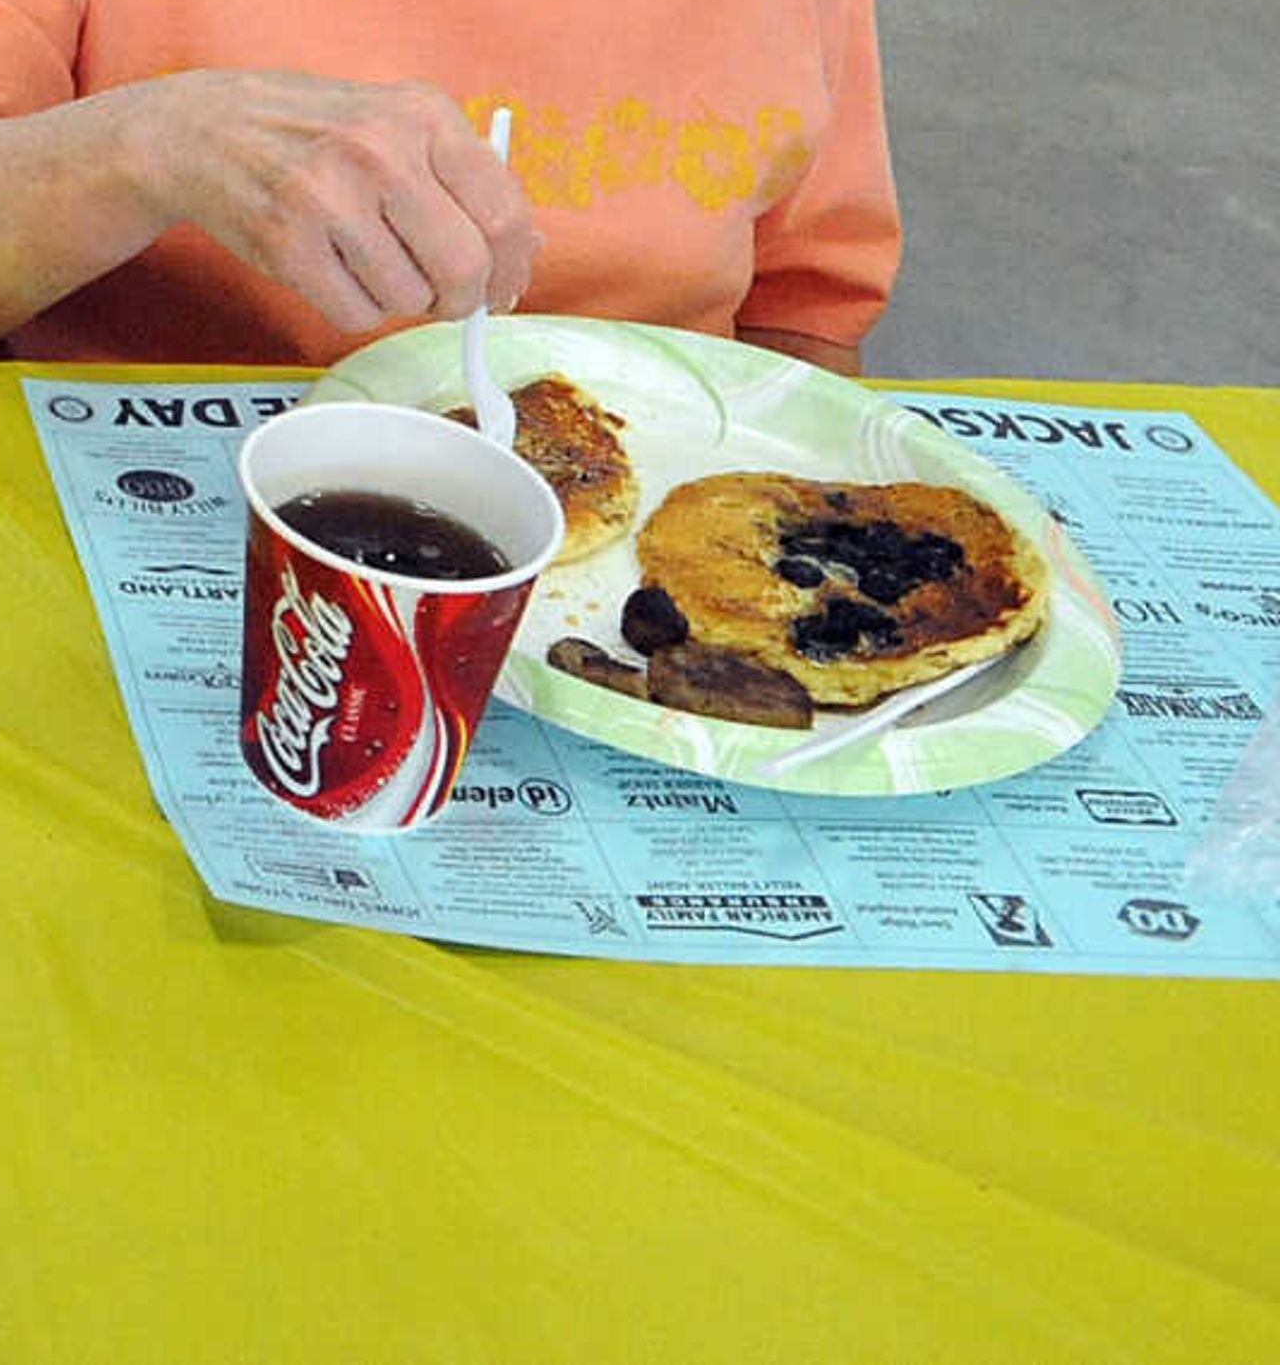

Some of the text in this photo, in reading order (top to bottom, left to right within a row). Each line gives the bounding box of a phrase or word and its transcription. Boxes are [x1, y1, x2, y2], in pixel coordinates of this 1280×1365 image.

[113, 398, 243, 428] DAY
[901, 405, 1134, 452] JACKS
[119, 581, 240, 601] ARTLAND
[1113, 600, 1183, 625] HO
[646, 907, 833, 922] AMERICAN FAMILY
